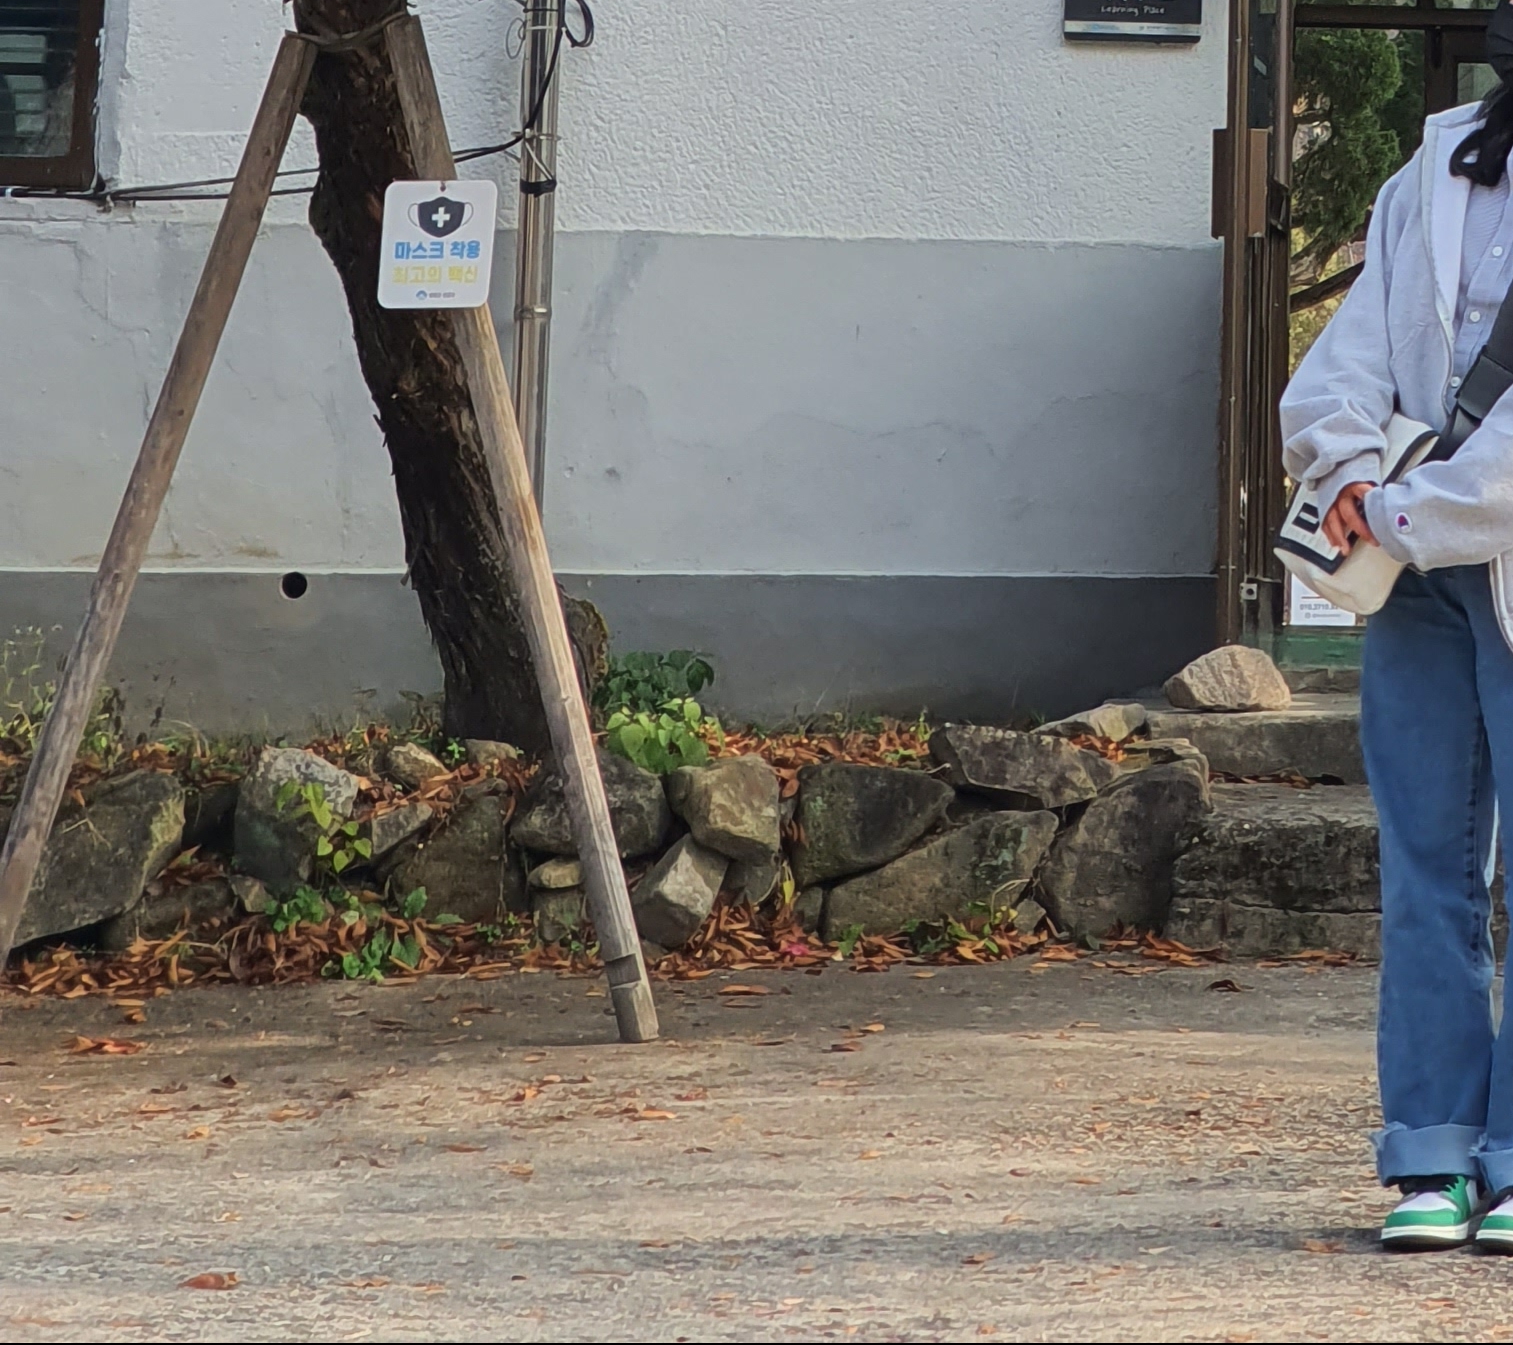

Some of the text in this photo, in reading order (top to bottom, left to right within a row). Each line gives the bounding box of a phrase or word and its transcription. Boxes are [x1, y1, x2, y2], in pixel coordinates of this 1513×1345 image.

[394, 240, 481, 260] 마스크 착용
[392, 266, 478, 284] 최고의 백신
